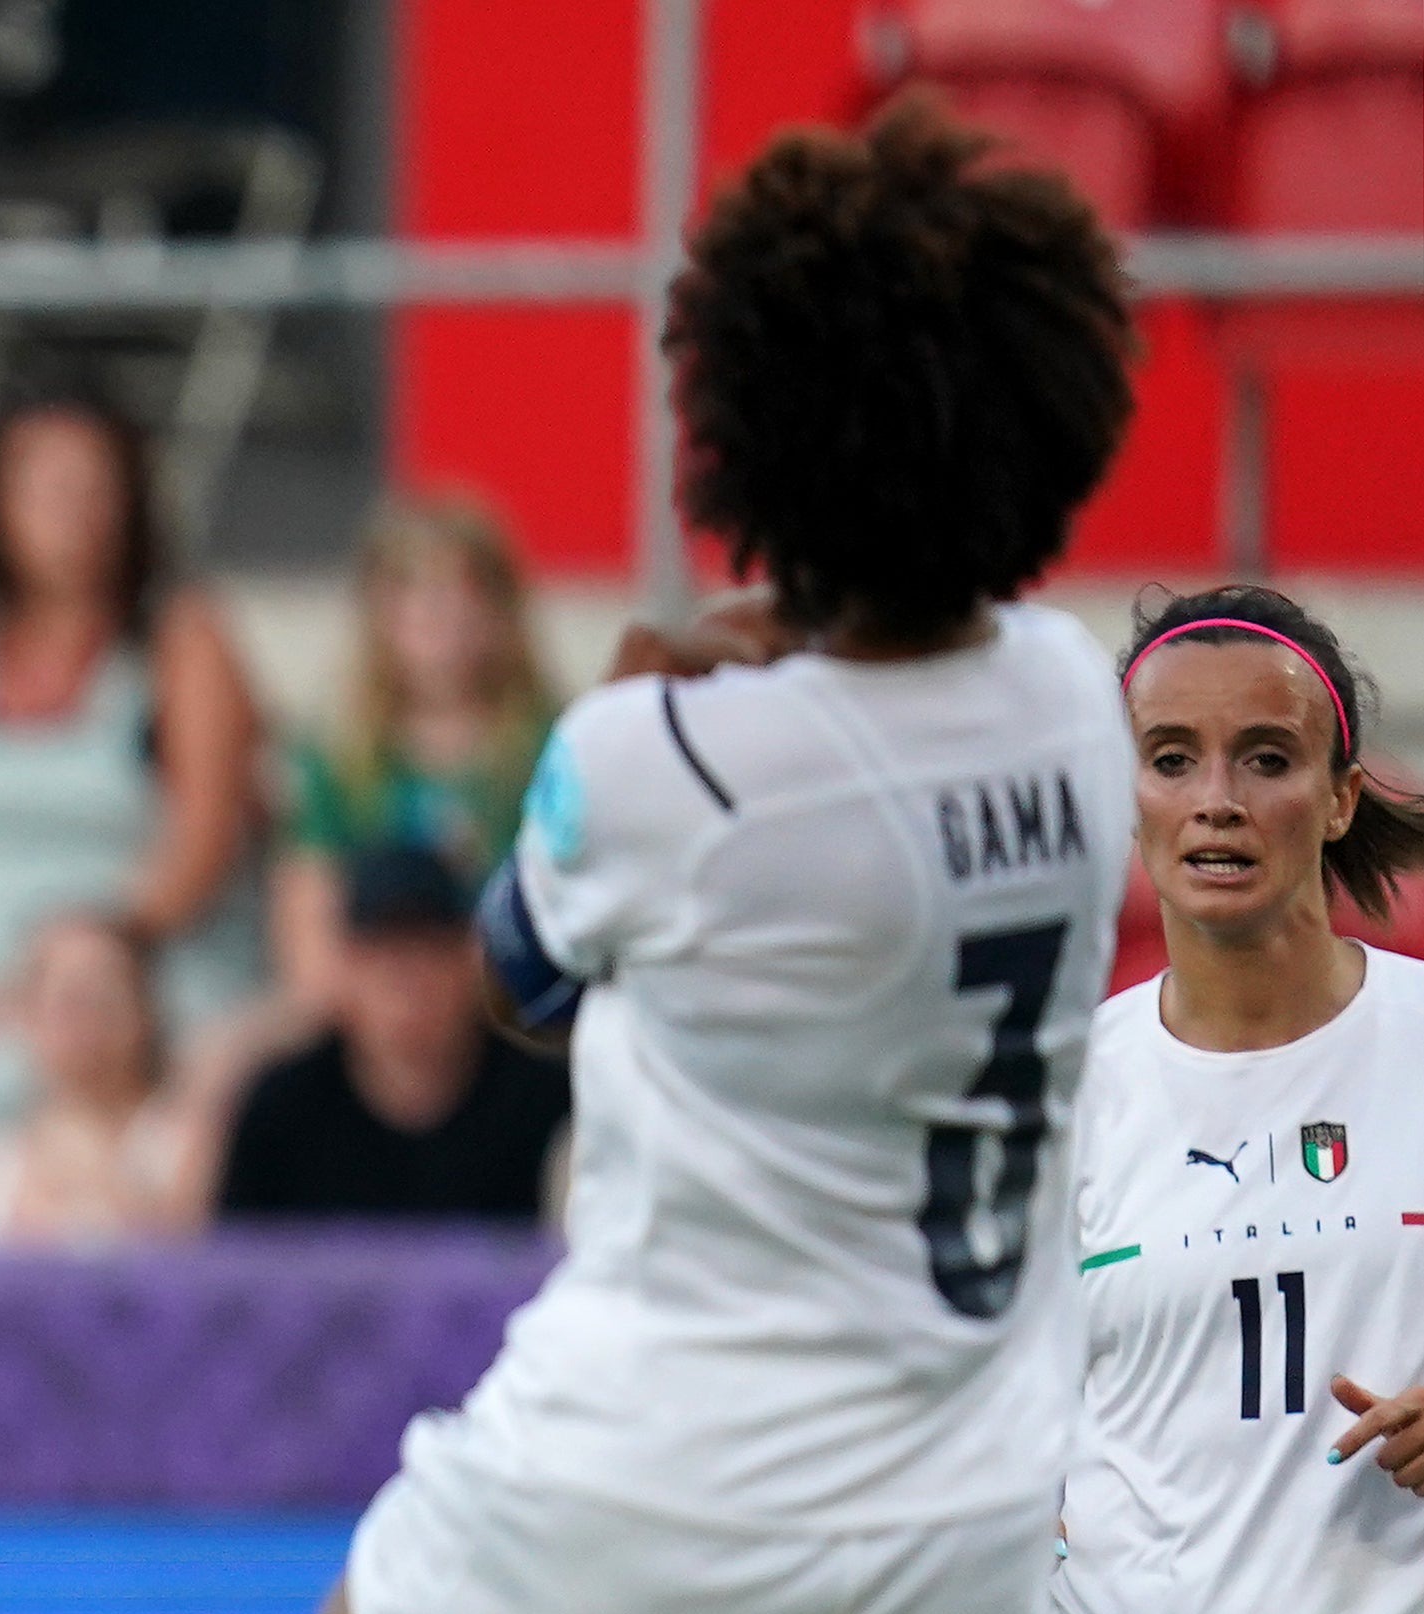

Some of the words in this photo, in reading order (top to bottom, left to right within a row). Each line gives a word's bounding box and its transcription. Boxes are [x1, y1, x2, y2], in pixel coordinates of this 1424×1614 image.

[937, 768, 1086, 880] GAMA
[919, 917, 1072, 1321] 3
[1184, 1216, 1357, 1249] ITALIA
[1231, 1270, 1305, 1420] 11
